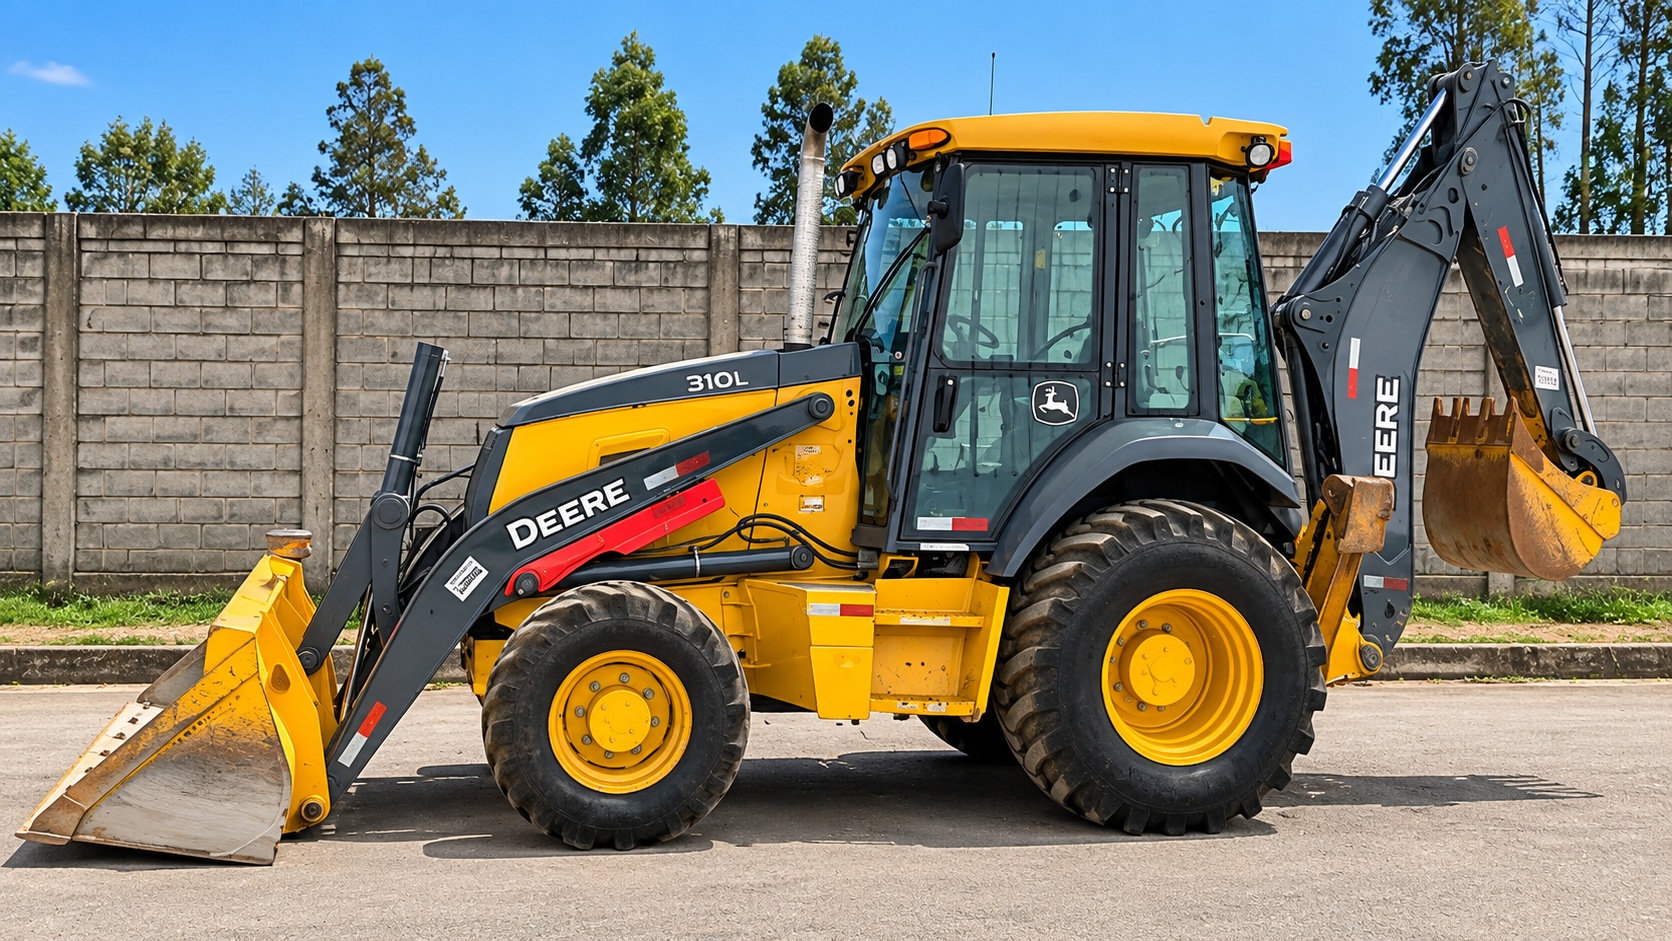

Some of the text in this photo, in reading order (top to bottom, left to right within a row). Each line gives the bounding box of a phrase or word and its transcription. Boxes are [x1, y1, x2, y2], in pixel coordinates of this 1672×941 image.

[686, 371, 749, 392] 310L
[1374, 377, 1399, 478] EERE
[506, 478, 630, 550] DEERE
